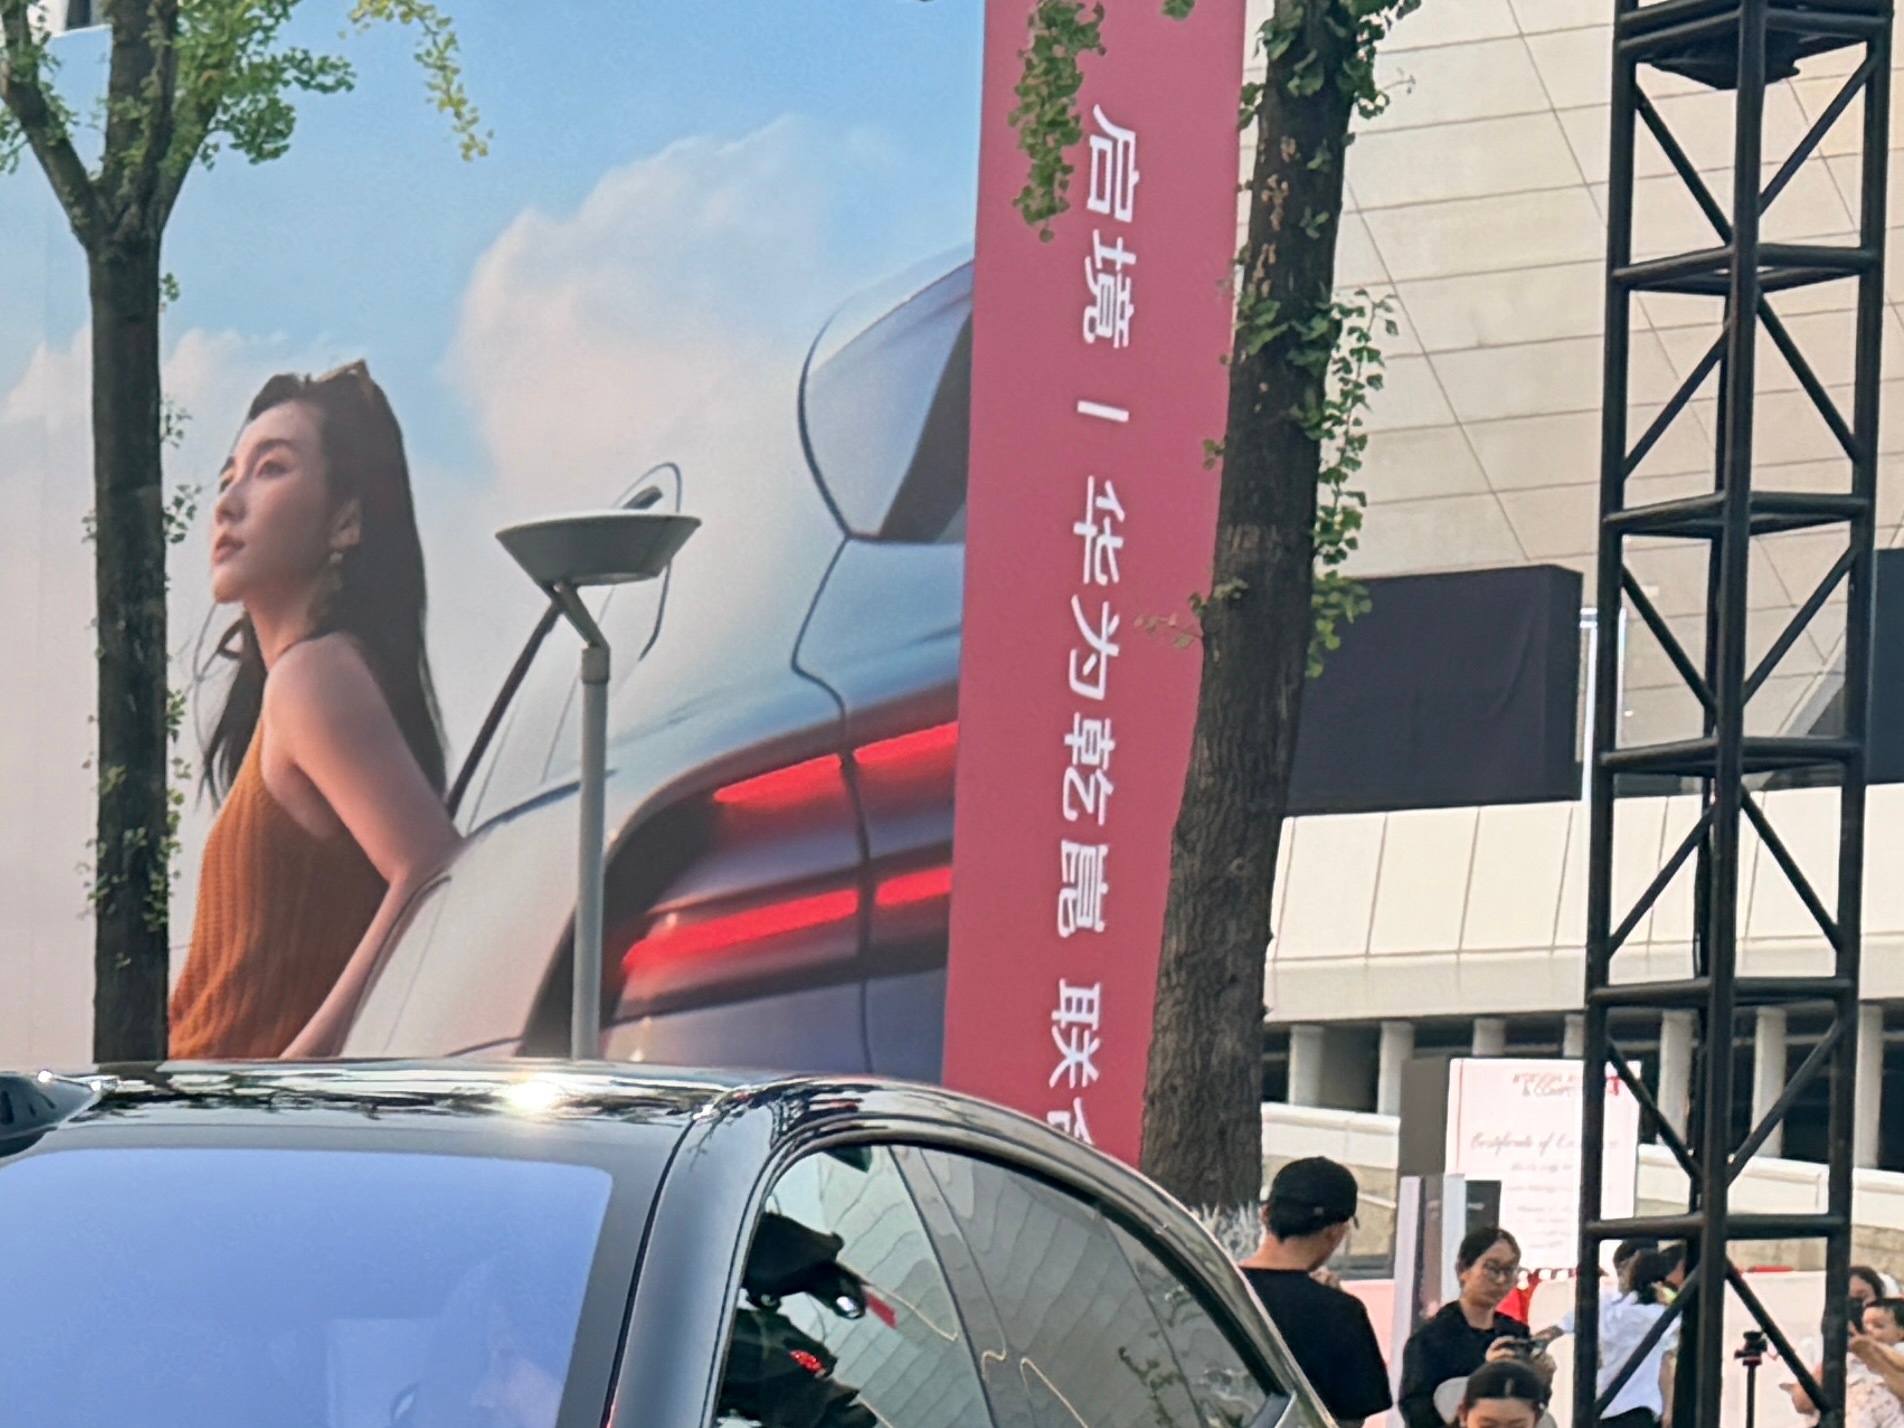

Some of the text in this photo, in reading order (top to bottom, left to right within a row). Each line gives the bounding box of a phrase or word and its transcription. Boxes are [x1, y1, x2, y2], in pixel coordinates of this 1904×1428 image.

[1083, 103, 1140, 349] 启境
[1057, 475, 1125, 938] 华为乾崑
